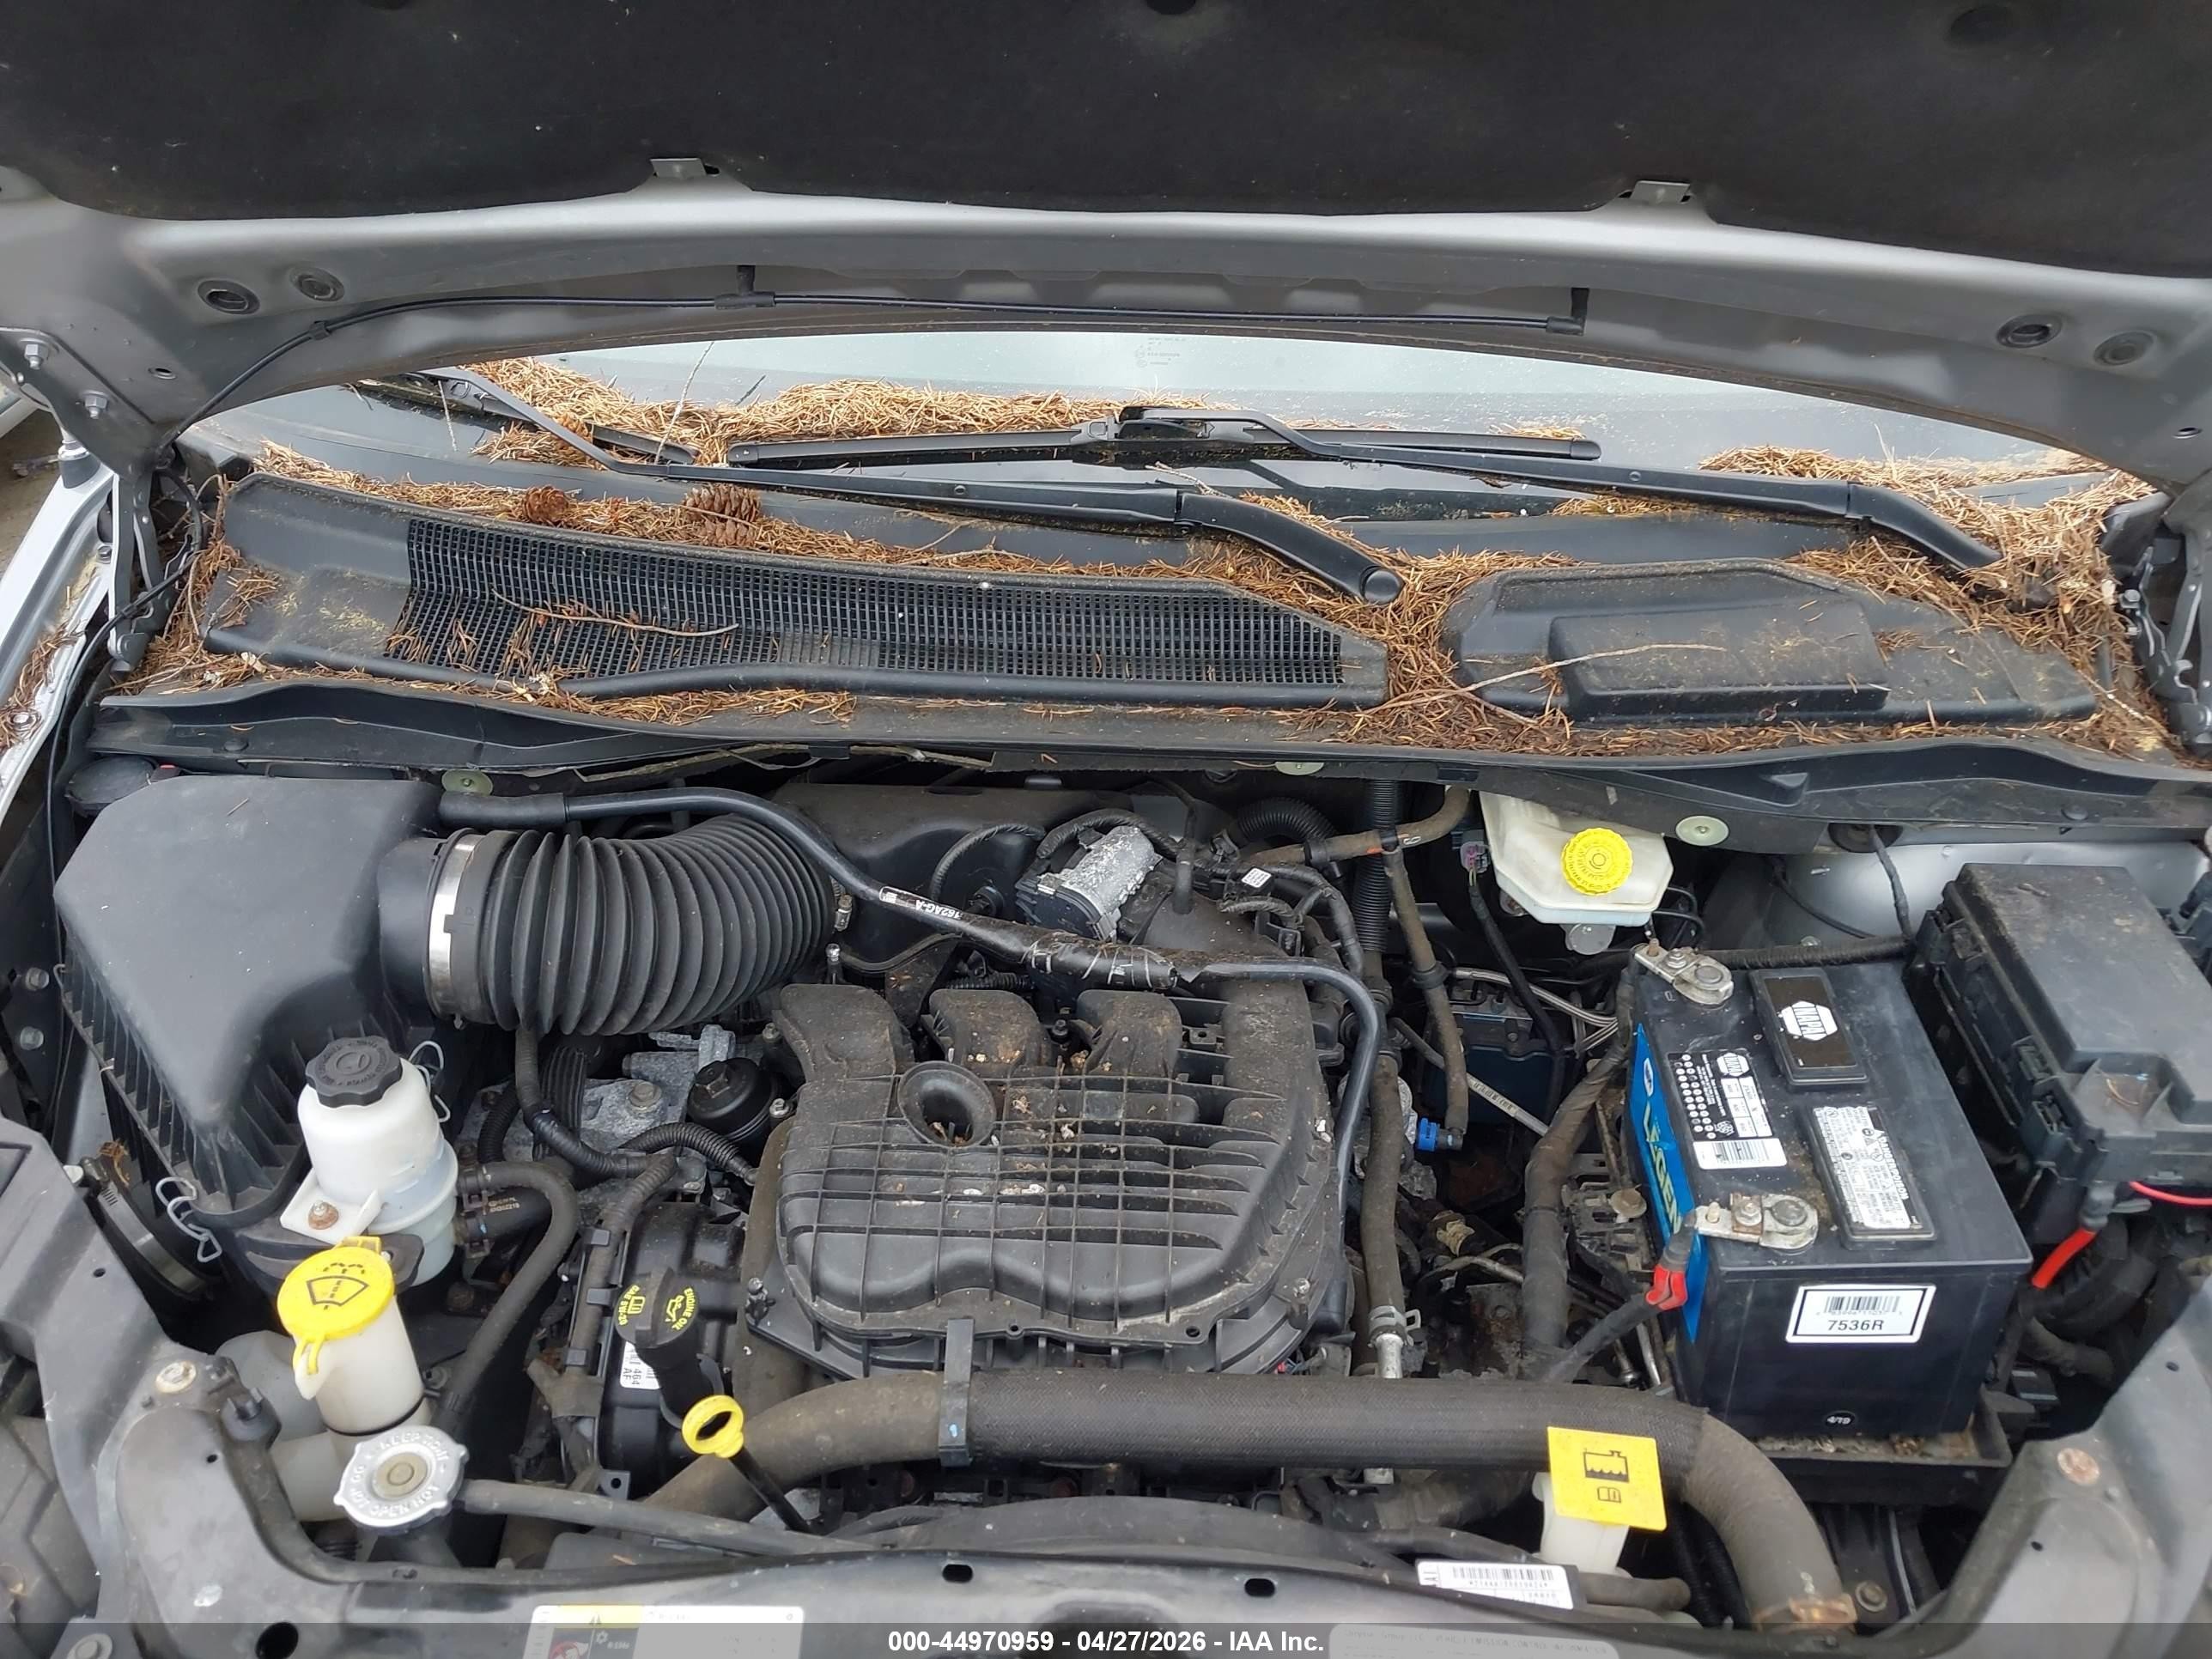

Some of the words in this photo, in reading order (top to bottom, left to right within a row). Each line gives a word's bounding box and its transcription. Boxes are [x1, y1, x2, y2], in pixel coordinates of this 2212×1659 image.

[1792, 1007, 1826, 1035] NAPA
[684, 1287, 696, 1317] ENGINE
[672, 1318, 688, 1331] OIL
[1826, 1320, 1885, 1332] 7536R
[1826, 1415, 1851, 1425] 4/19
[380, 1431, 421, 1450] KEEP
[370, 1504, 410, 1517] OPEN
[412, 1485, 440, 1507] HOT
